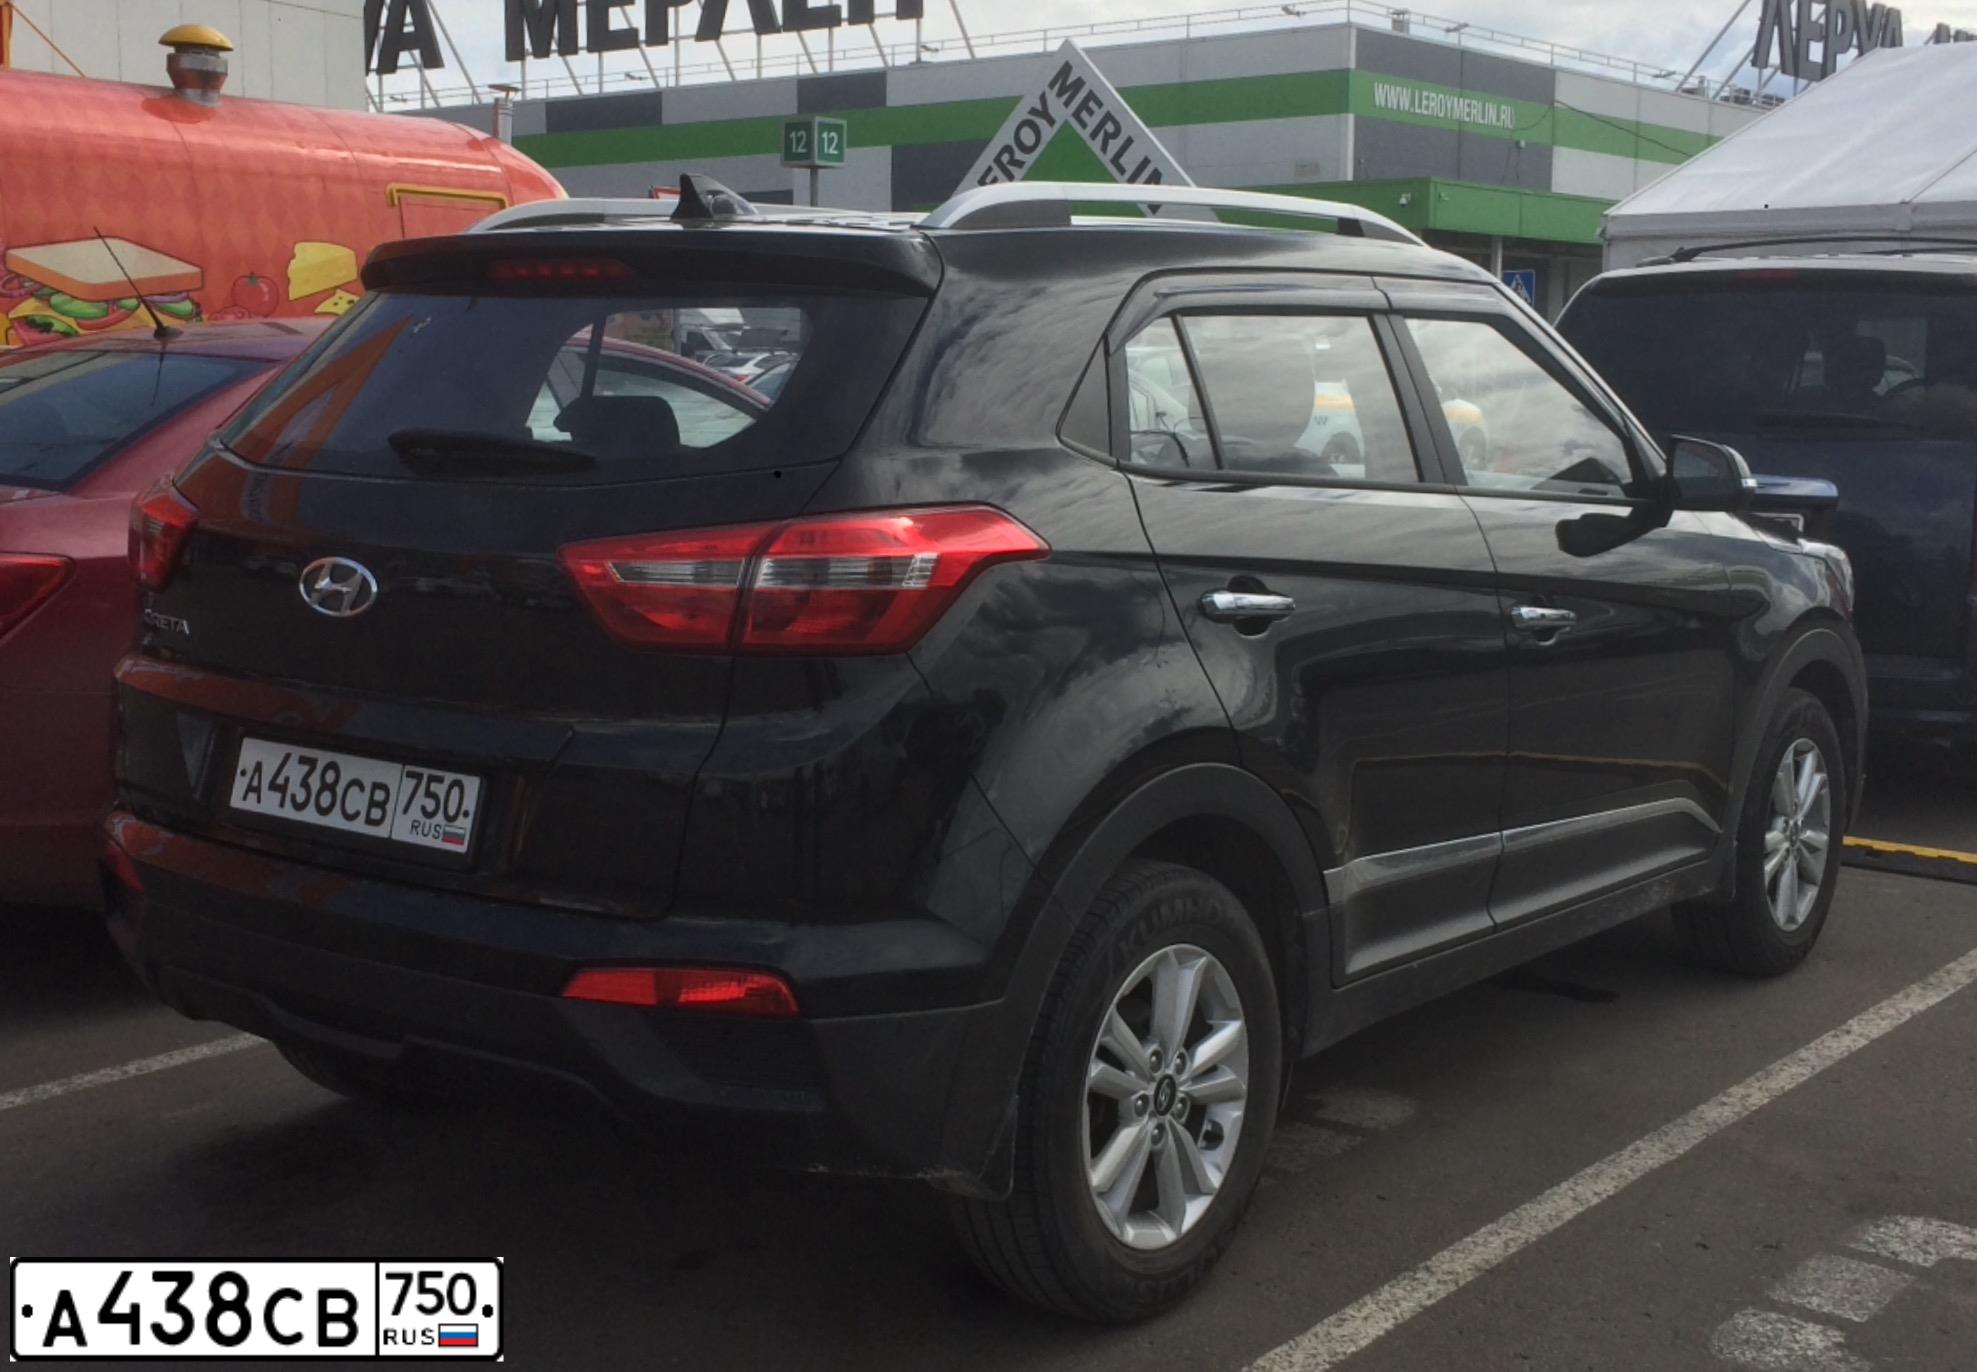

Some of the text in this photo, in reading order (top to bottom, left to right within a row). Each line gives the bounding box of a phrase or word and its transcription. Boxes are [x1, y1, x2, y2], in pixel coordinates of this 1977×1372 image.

[1374, 81, 1515, 129] WWW.LEROYMERLIN.RU
[788, 129, 808, 153] 12
[821, 131, 839, 154] 12
[402, 770, 465, 823] 750
[410, 819, 442, 840] RUS
